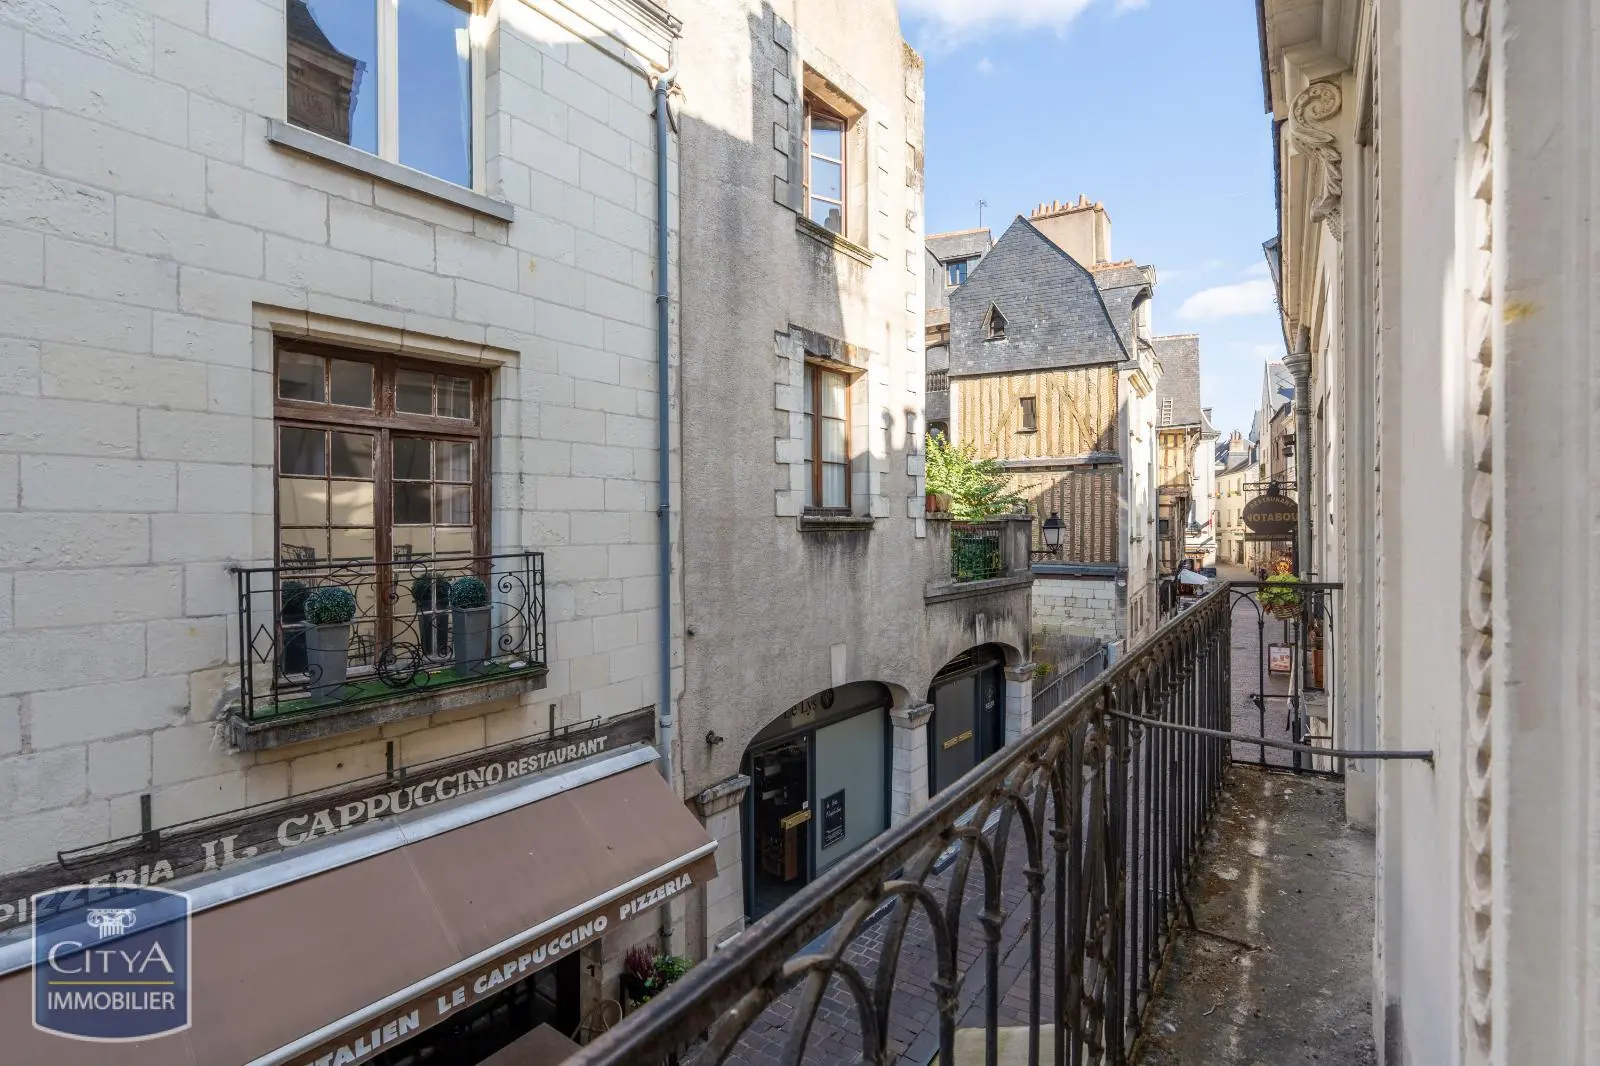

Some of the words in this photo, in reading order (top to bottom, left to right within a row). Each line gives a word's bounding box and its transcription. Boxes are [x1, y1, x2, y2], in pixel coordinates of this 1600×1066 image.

[801, 699, 818, 716] Lys
[201, 834, 258, 872] IL
[277, 762, 503, 848] CAPPUCCINO
[507, 735, 608, 779] RESTAURANT
[305, 1009, 420, 1066] TALIEN
[437, 985, 466, 1015] LE
[474, 915, 608, 994] CAPPUCCINO
[619, 872, 693, 922] PIZZERIA
